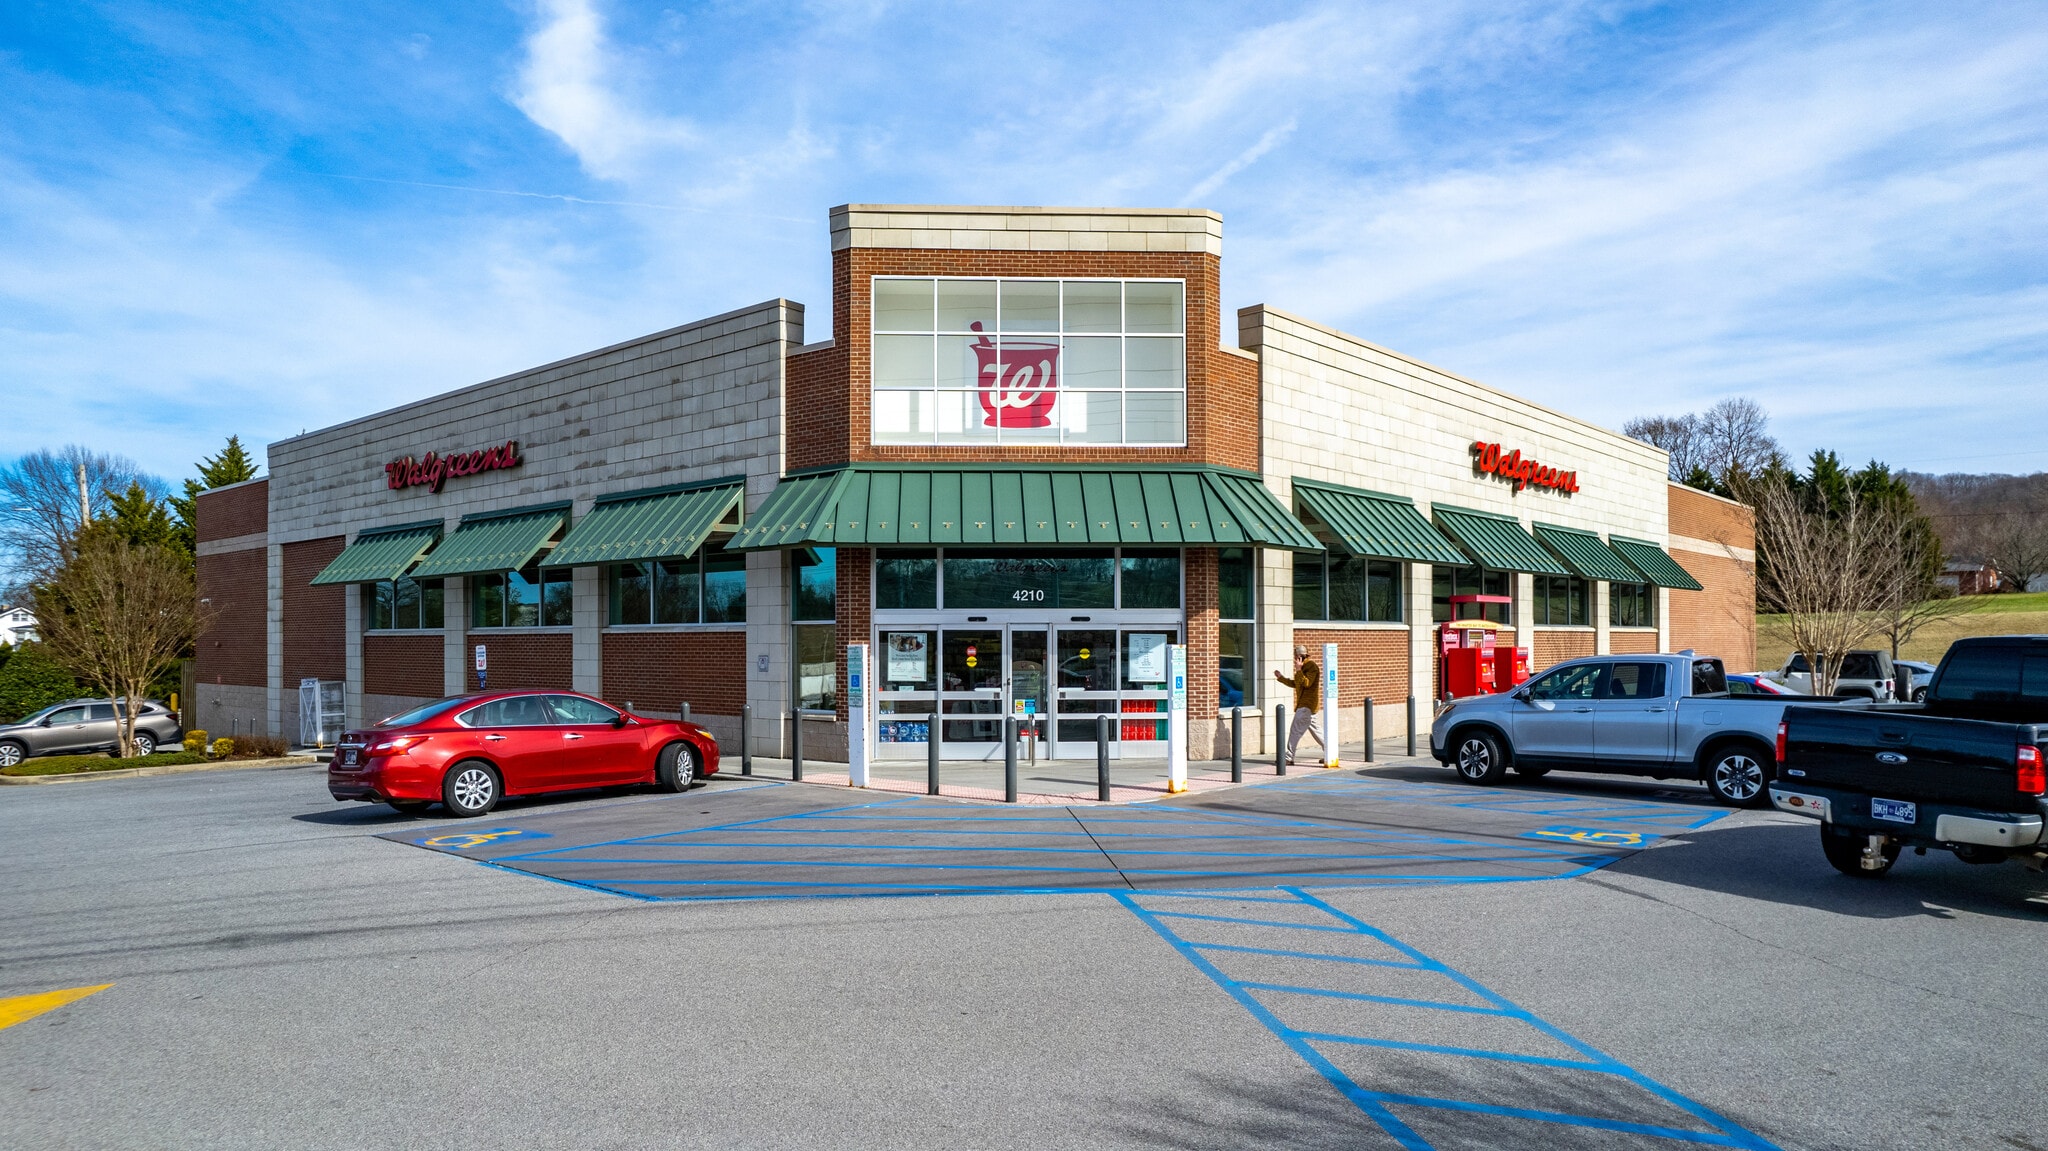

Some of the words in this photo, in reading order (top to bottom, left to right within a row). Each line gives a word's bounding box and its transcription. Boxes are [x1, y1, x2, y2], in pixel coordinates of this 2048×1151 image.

[385, 440, 516, 493] Walgreens
[1474, 441, 1580, 493] Walgreens
[1012, 589, 1044, 601] 4210
[1874, 803, 1888, 814] BKH
[1894, 806, 1913, 818] 4895
